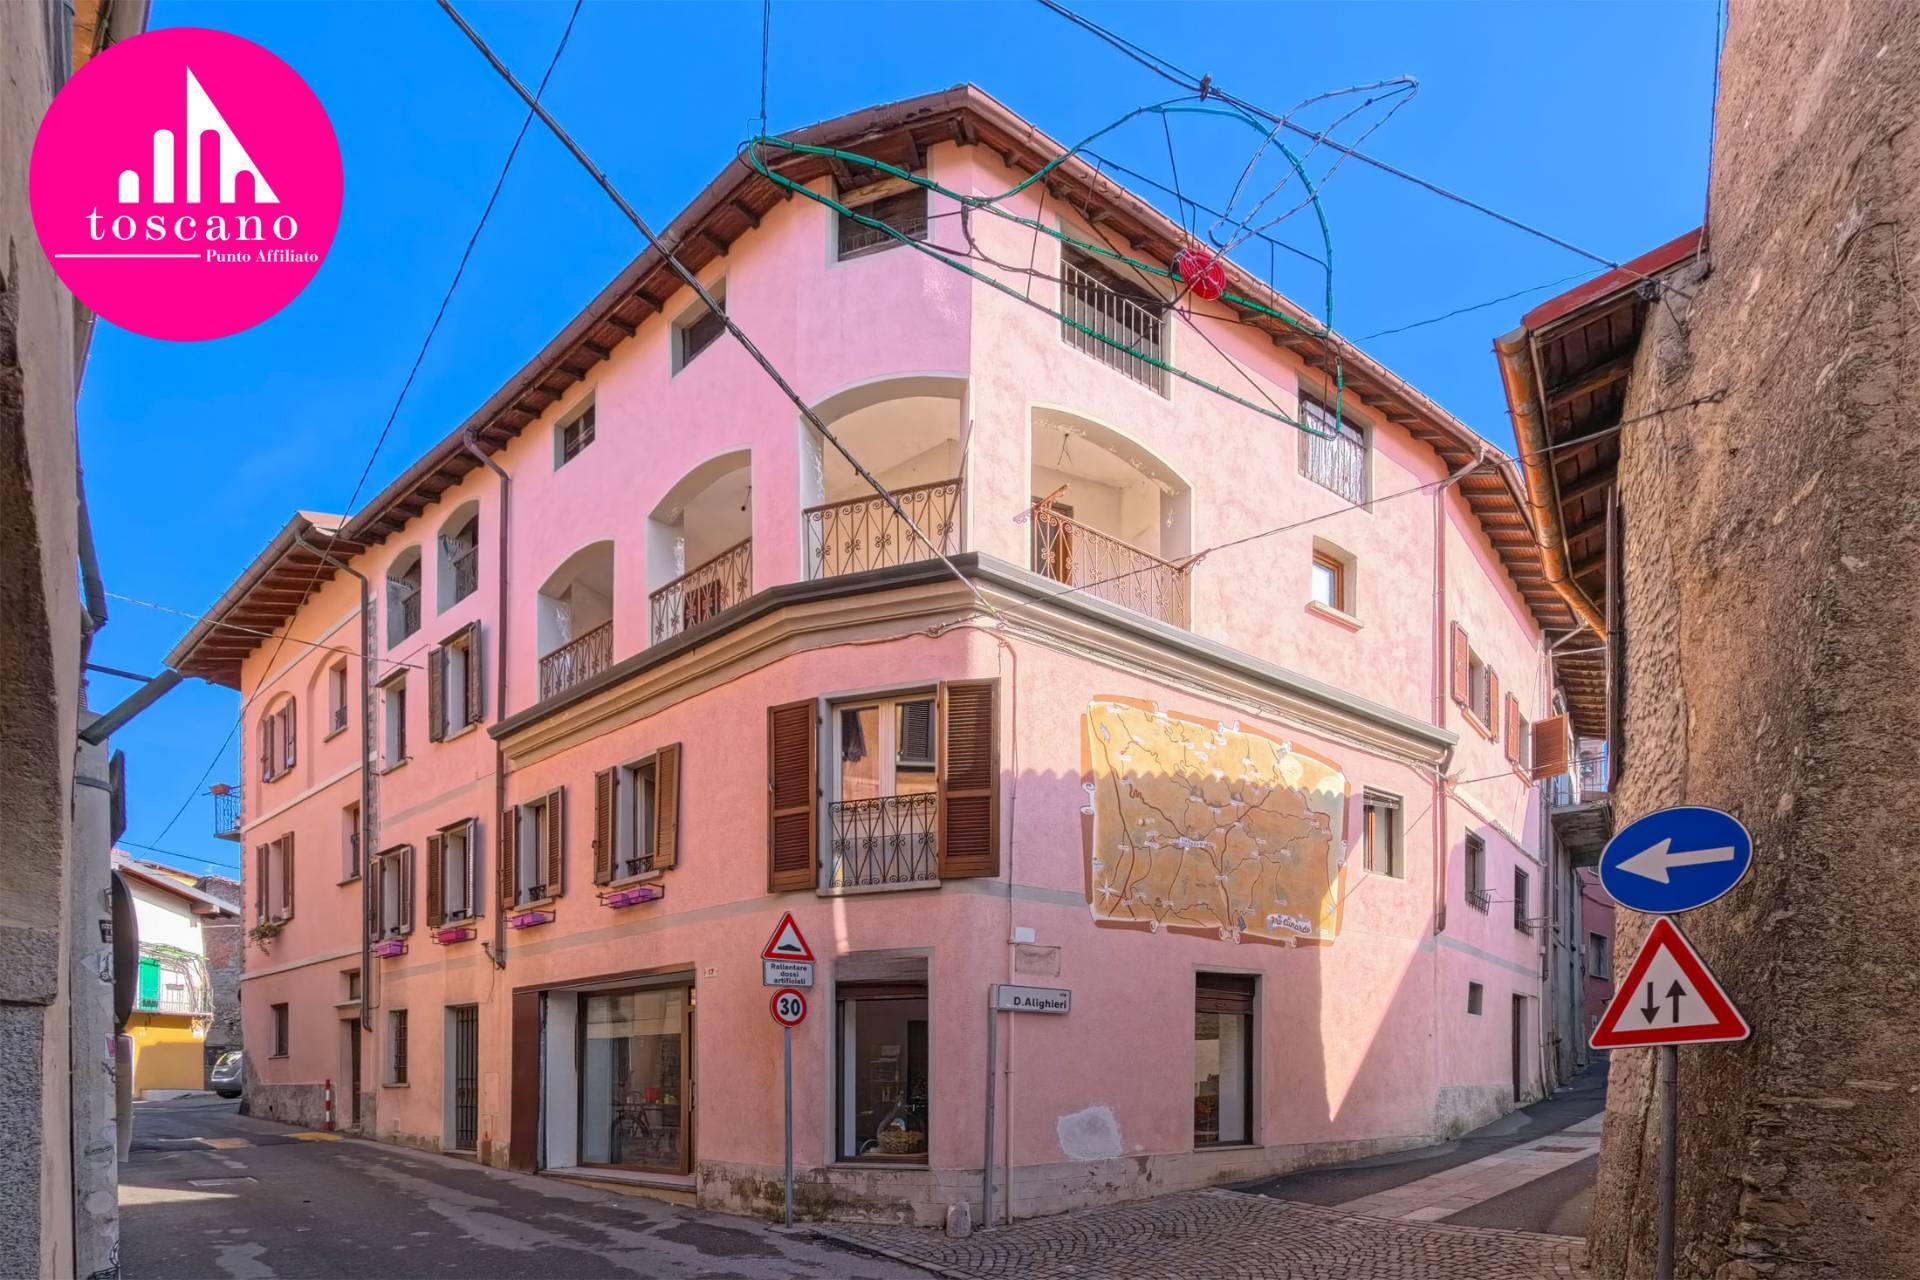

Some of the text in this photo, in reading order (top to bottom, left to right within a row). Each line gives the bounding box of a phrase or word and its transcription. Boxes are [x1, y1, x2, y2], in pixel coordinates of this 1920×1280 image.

[770, 963, 807, 972] Rallentare
[780, 998, 801, 1016] 30
[1013, 996, 1067, 1009] D.Alighieri
